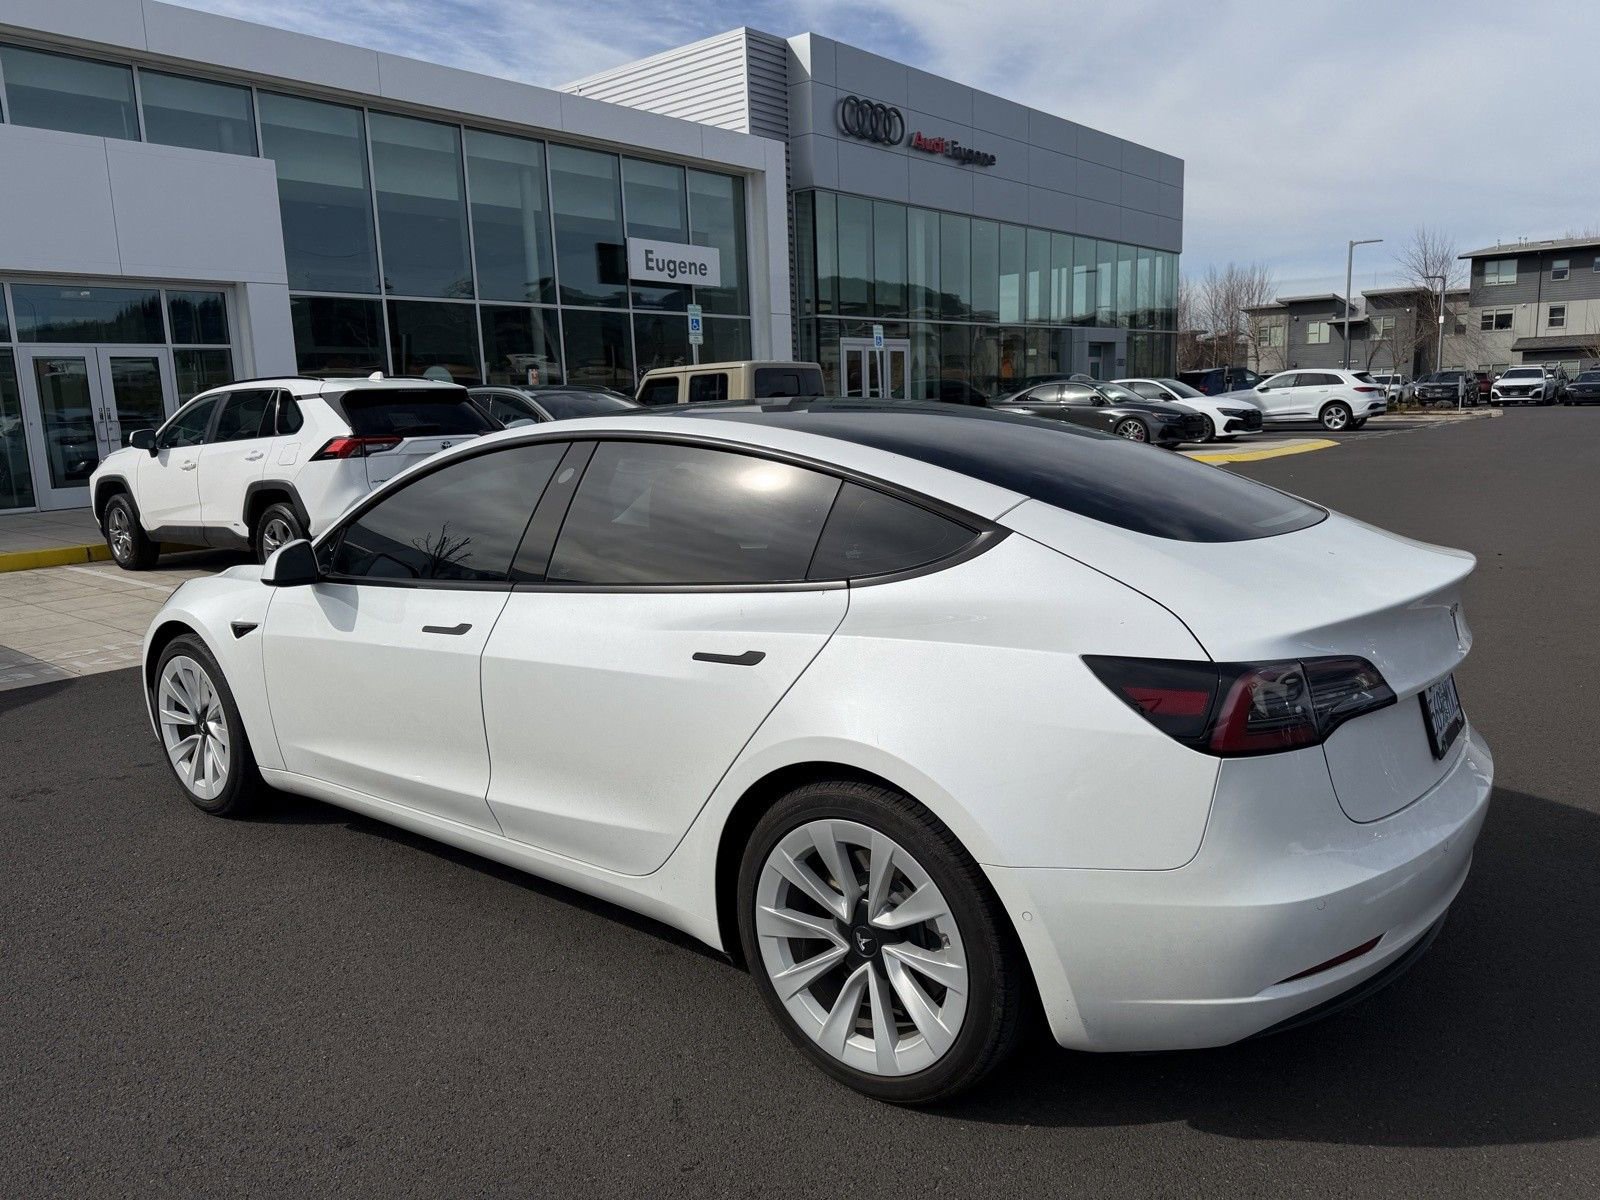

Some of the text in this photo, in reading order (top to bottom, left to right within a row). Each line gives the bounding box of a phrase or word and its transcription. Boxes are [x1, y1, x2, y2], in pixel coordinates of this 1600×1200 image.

[912, 131, 996, 166] Audi Eugene
[644, 249, 708, 279] Eugene
